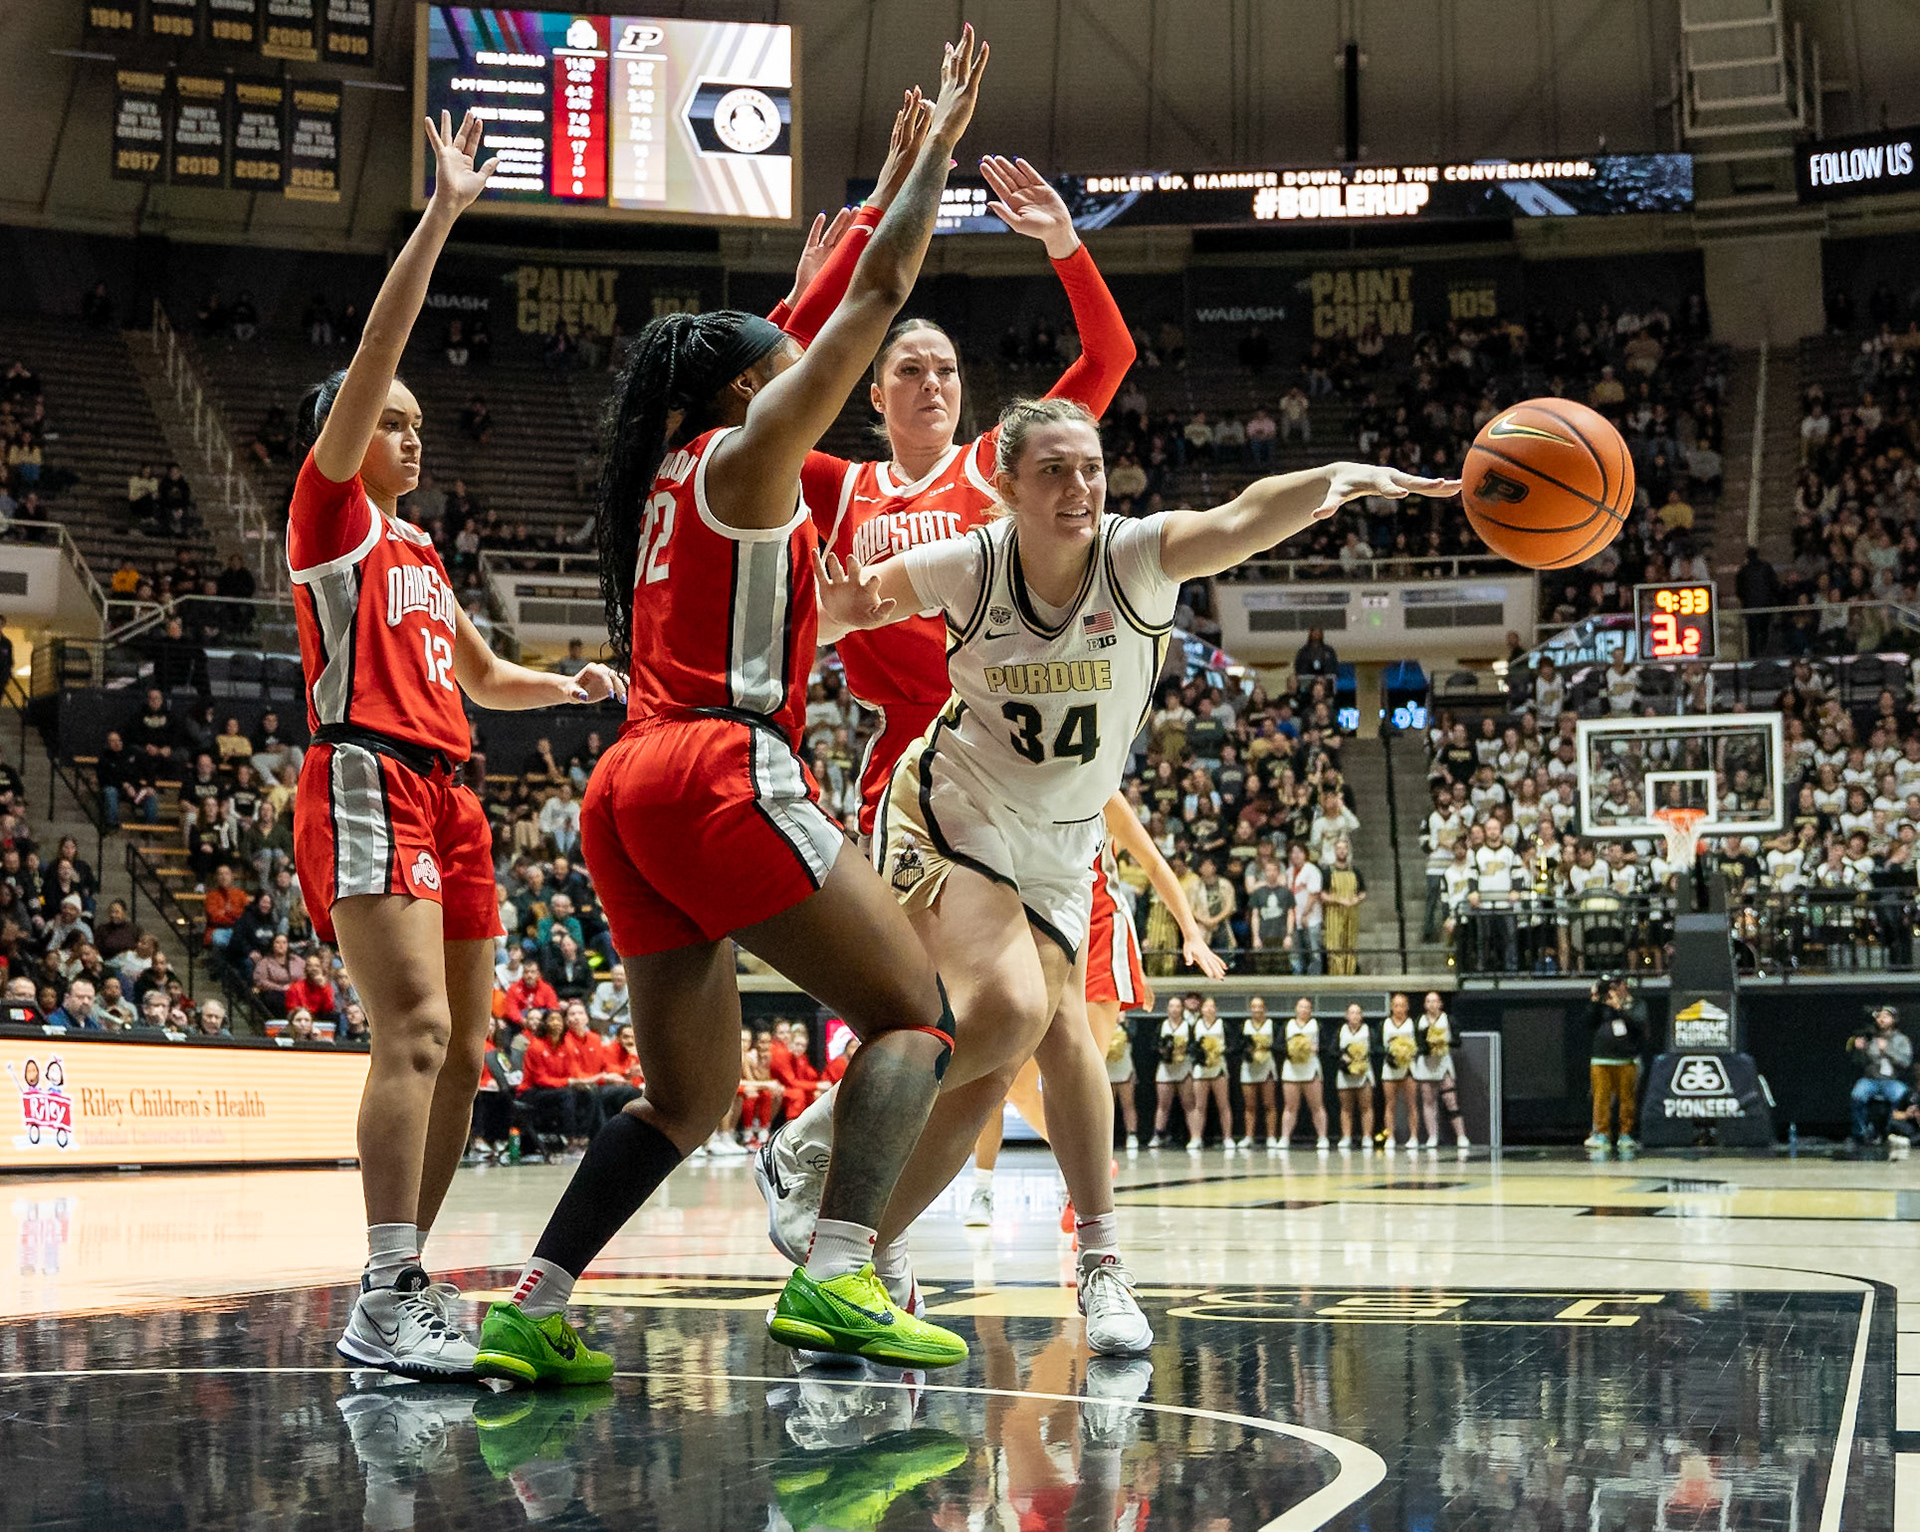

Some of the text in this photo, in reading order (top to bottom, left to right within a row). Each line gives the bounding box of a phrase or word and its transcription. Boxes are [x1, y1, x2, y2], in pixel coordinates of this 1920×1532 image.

[1086, 161, 1597, 193] BOILER UP. HAMMER DOWN. JOIN THE CONVERSATION.
[1810, 142, 1914, 187] FOLLOW US
[1253, 182, 1430, 220] #BOILERUP
[517, 266, 618, 300] PAINT
[1312, 268, 1412, 302] PAINT
[517, 301, 618, 336] CREW
[1196, 308, 1284, 322] WABASH
[1313, 300, 1414, 338] CREW
[1449, 289, 1496, 318] 105
[1655, 588, 1710, 615] 9:33
[1652, 613, 1701, 657] 3.2
[420, 627, 453, 692] 12
[984, 660, 1112, 694] PURDUE
[1001, 700, 1100, 766] 34
[30, 1096, 66, 1123] Riley
[81, 1088, 266, 1126] Riley Children's Health
